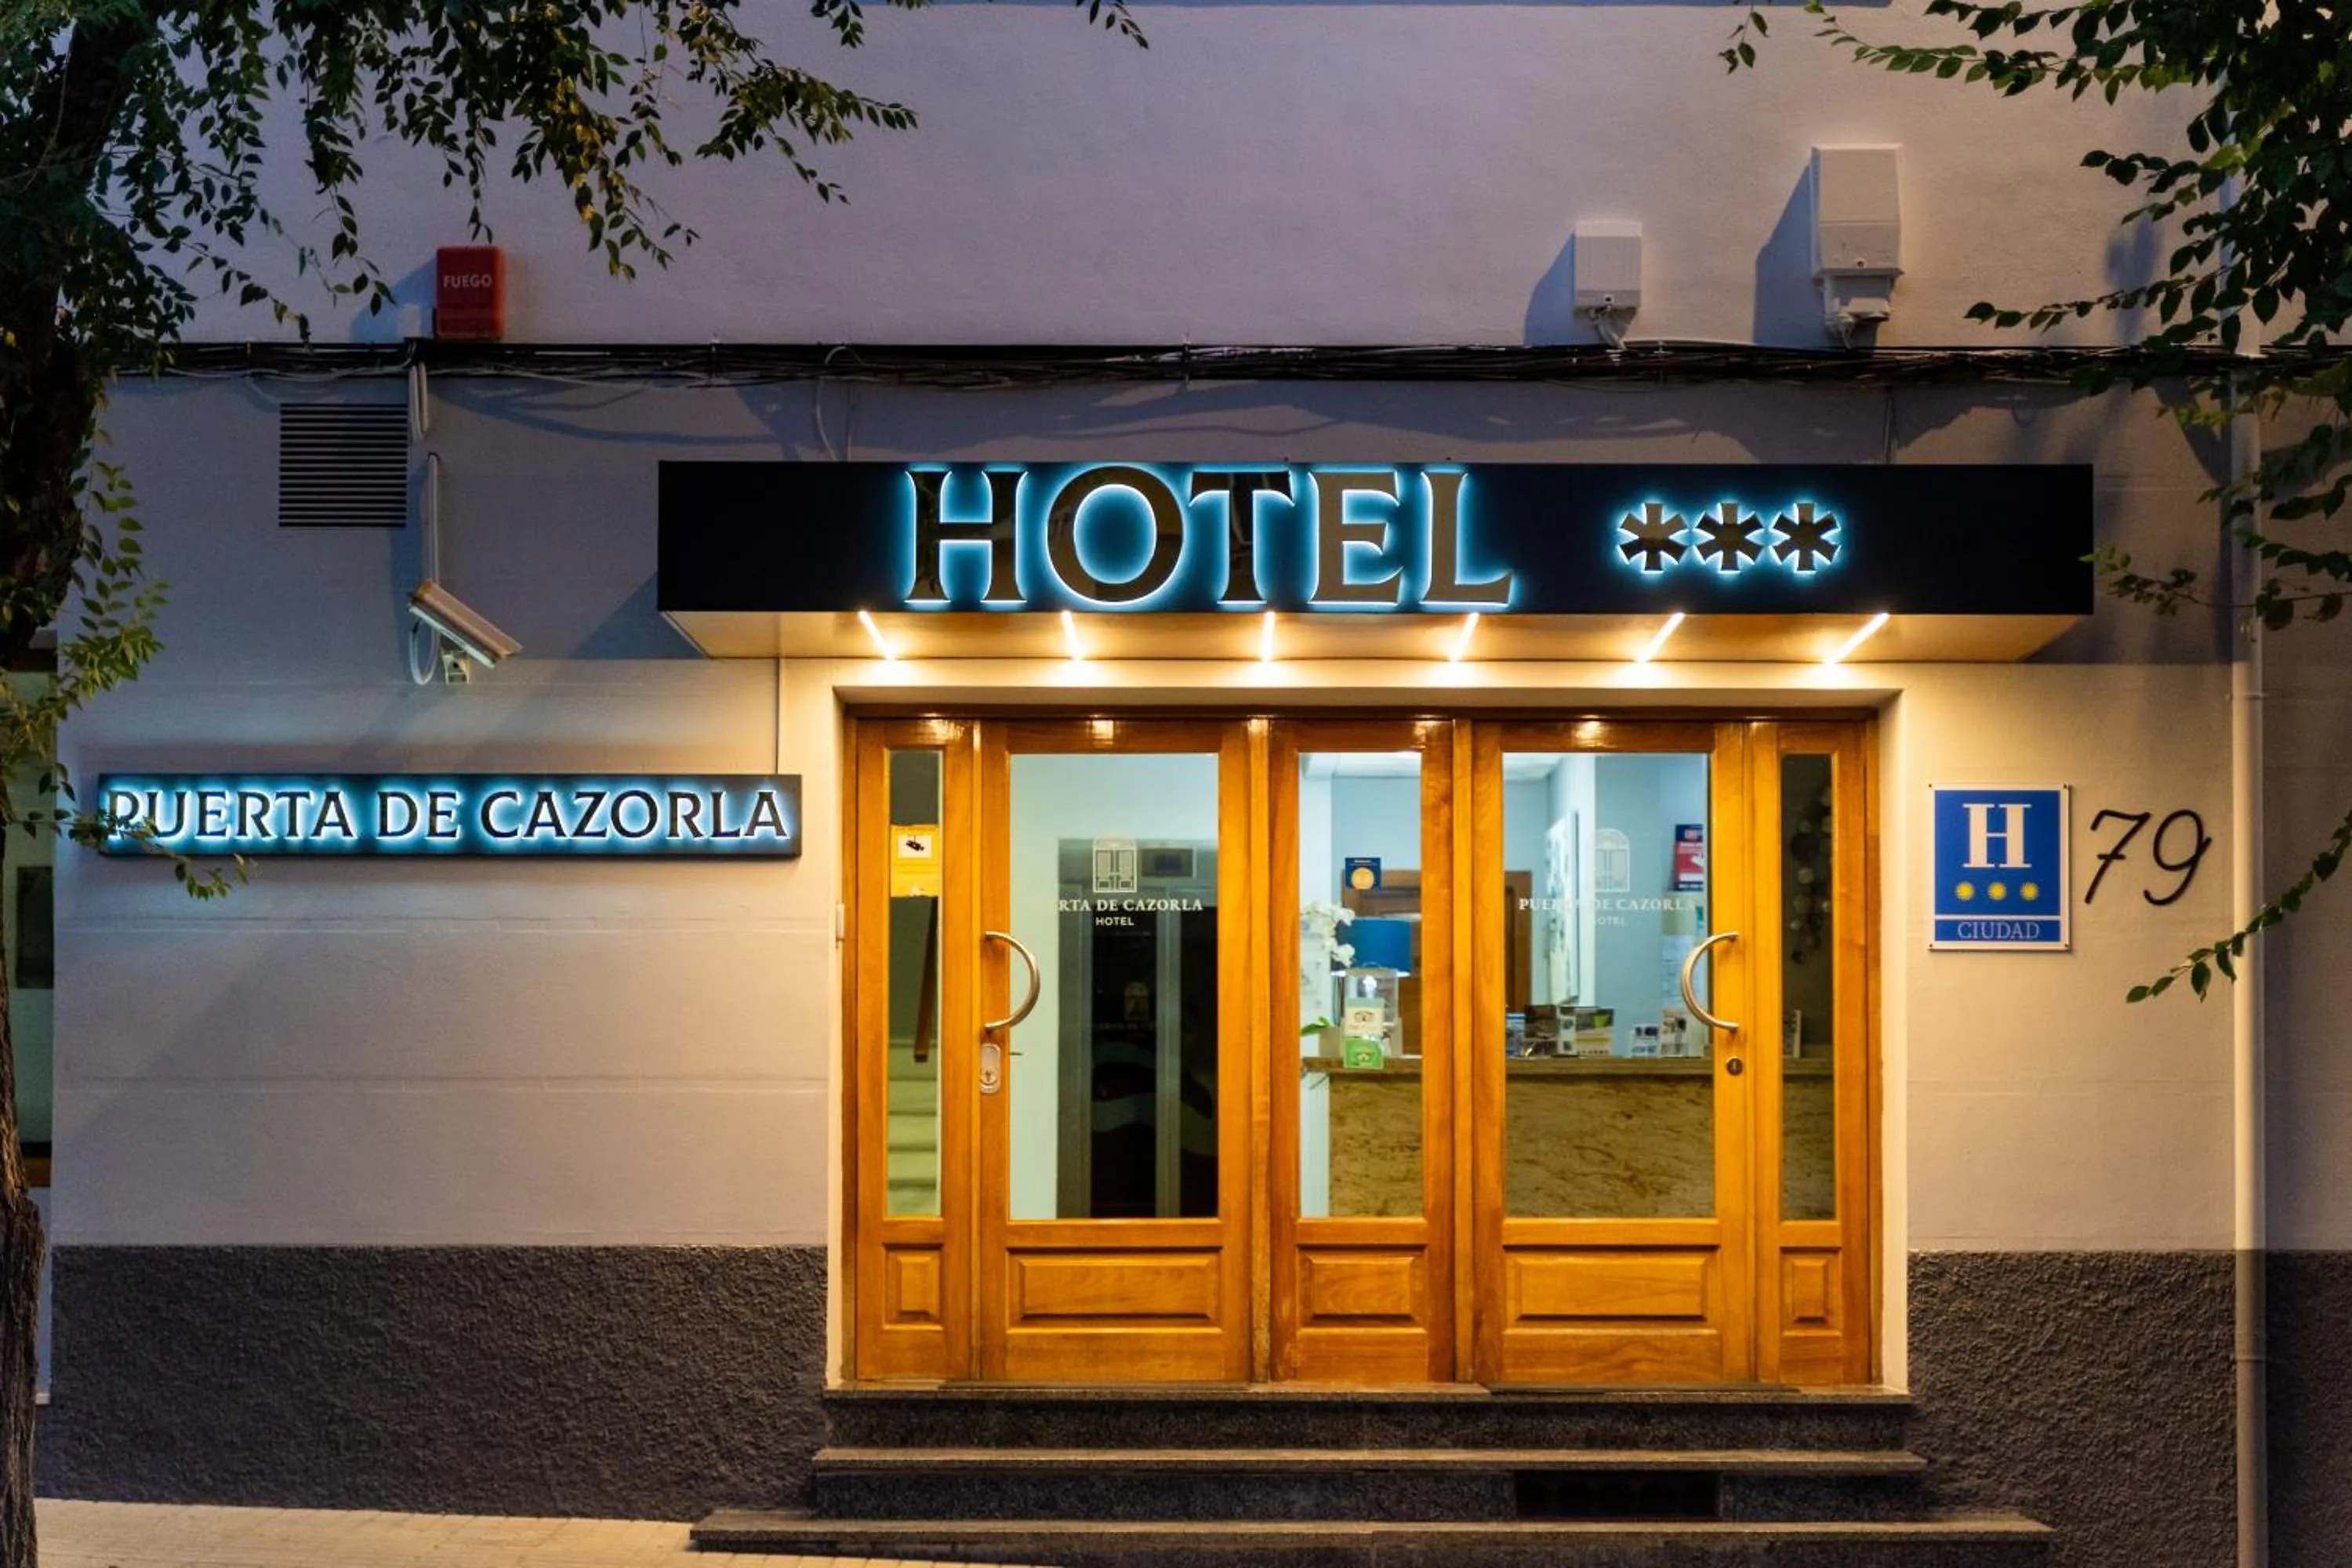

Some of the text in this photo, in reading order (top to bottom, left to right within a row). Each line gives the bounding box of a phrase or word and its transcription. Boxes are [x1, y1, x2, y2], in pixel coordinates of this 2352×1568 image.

[443, 274, 492, 289] FUEGO
[905, 465, 1514, 606] HOTEL
[107, 789, 789, 840] PUERTA DE CAZORLA
[1962, 804, 2032, 869] H
[2084, 809, 2212, 906] 79
[1095, 916, 1134, 927] HOTEL
[1098, 899, 1119, 912] DE
[1123, 899, 1203, 912] CAZORLA
[1957, 921, 2040, 941] CIUDAD
